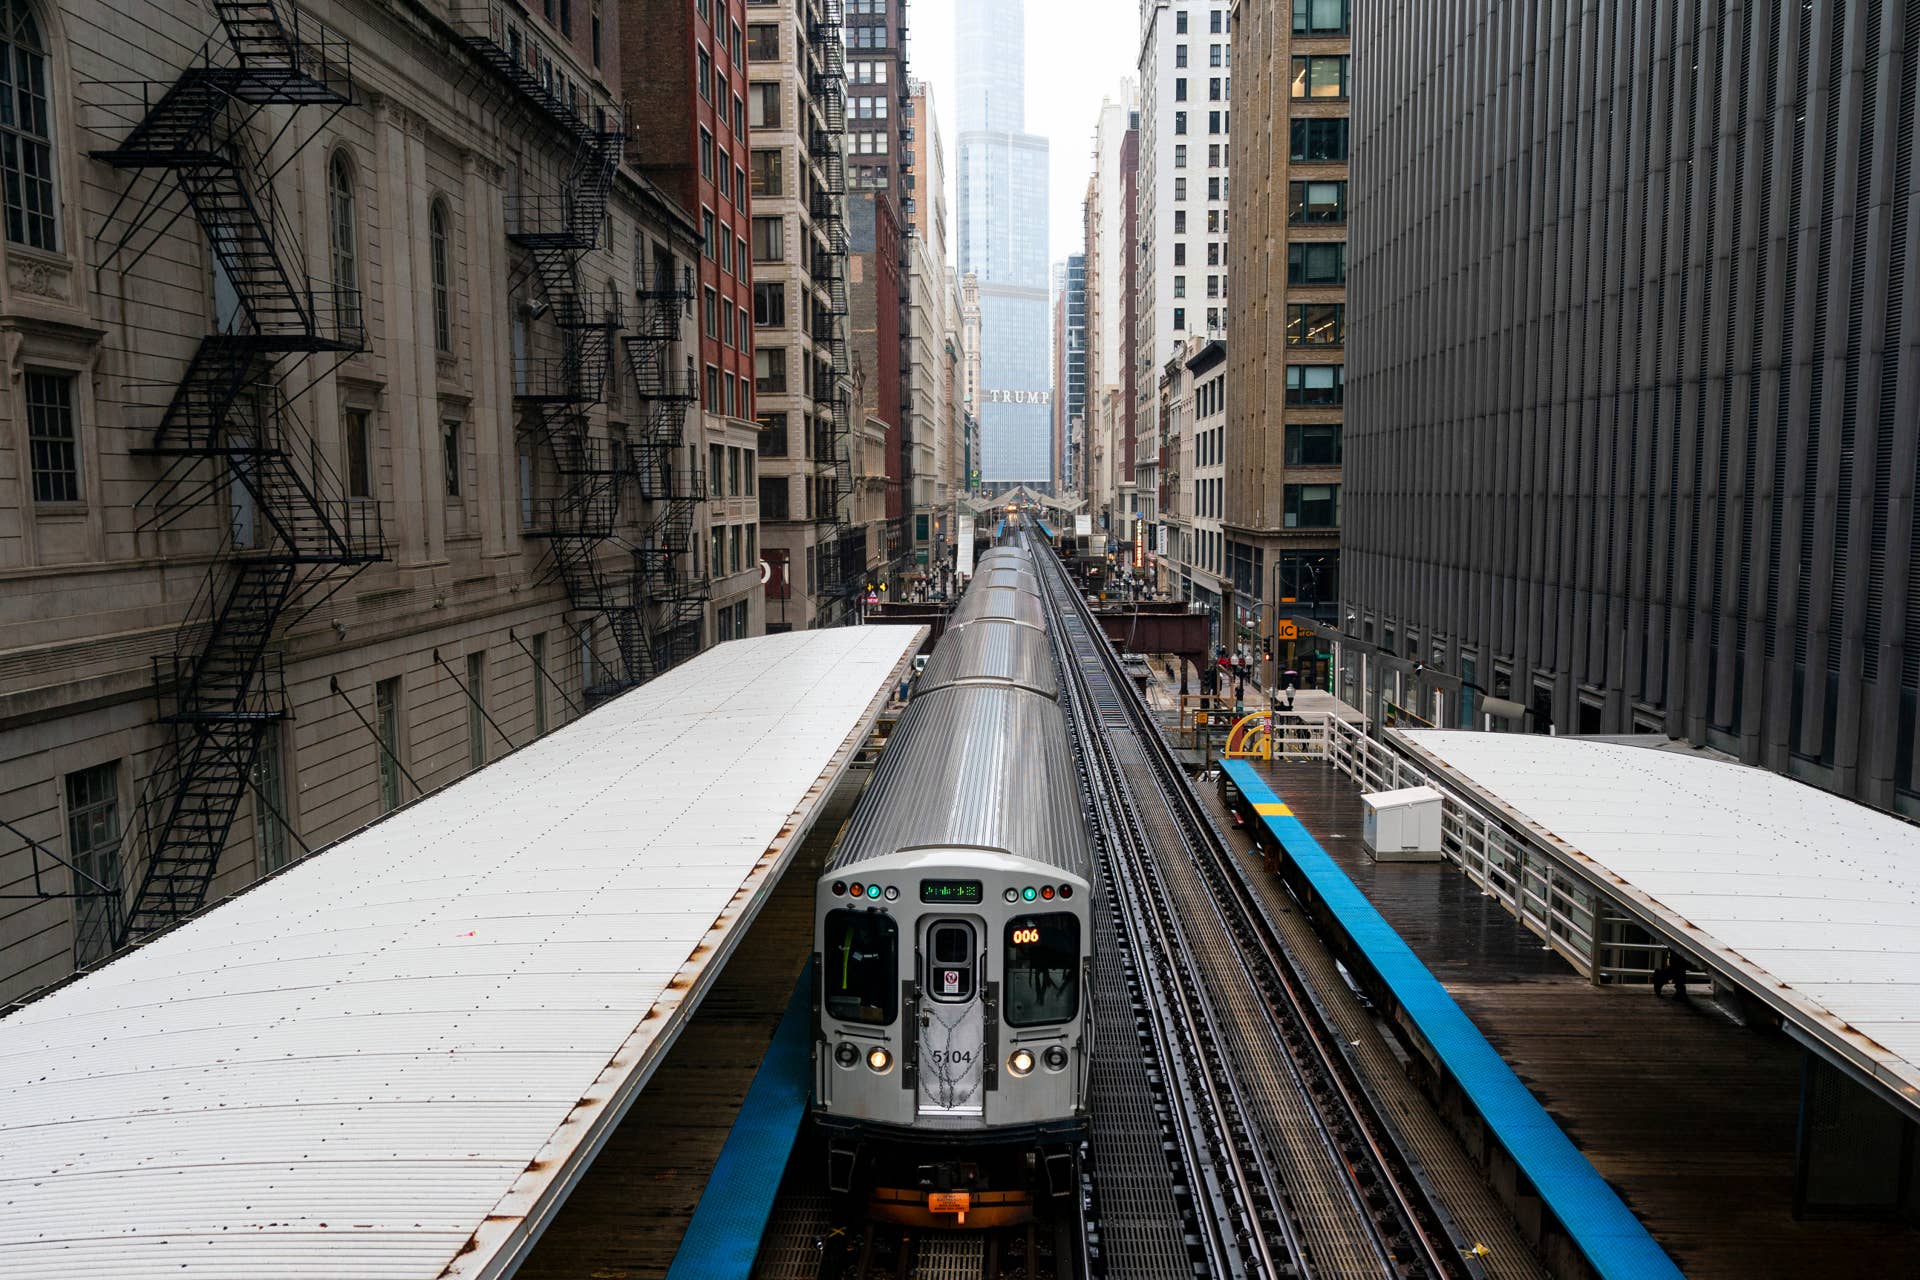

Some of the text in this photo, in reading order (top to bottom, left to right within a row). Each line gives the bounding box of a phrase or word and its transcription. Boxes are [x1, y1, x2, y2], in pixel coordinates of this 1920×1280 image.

[990, 389, 1049, 404] TRUMP
[1279, 625, 1294, 636] IC
[1013, 928, 1039, 944] 006
[933, 1050, 972, 1063] 5104
